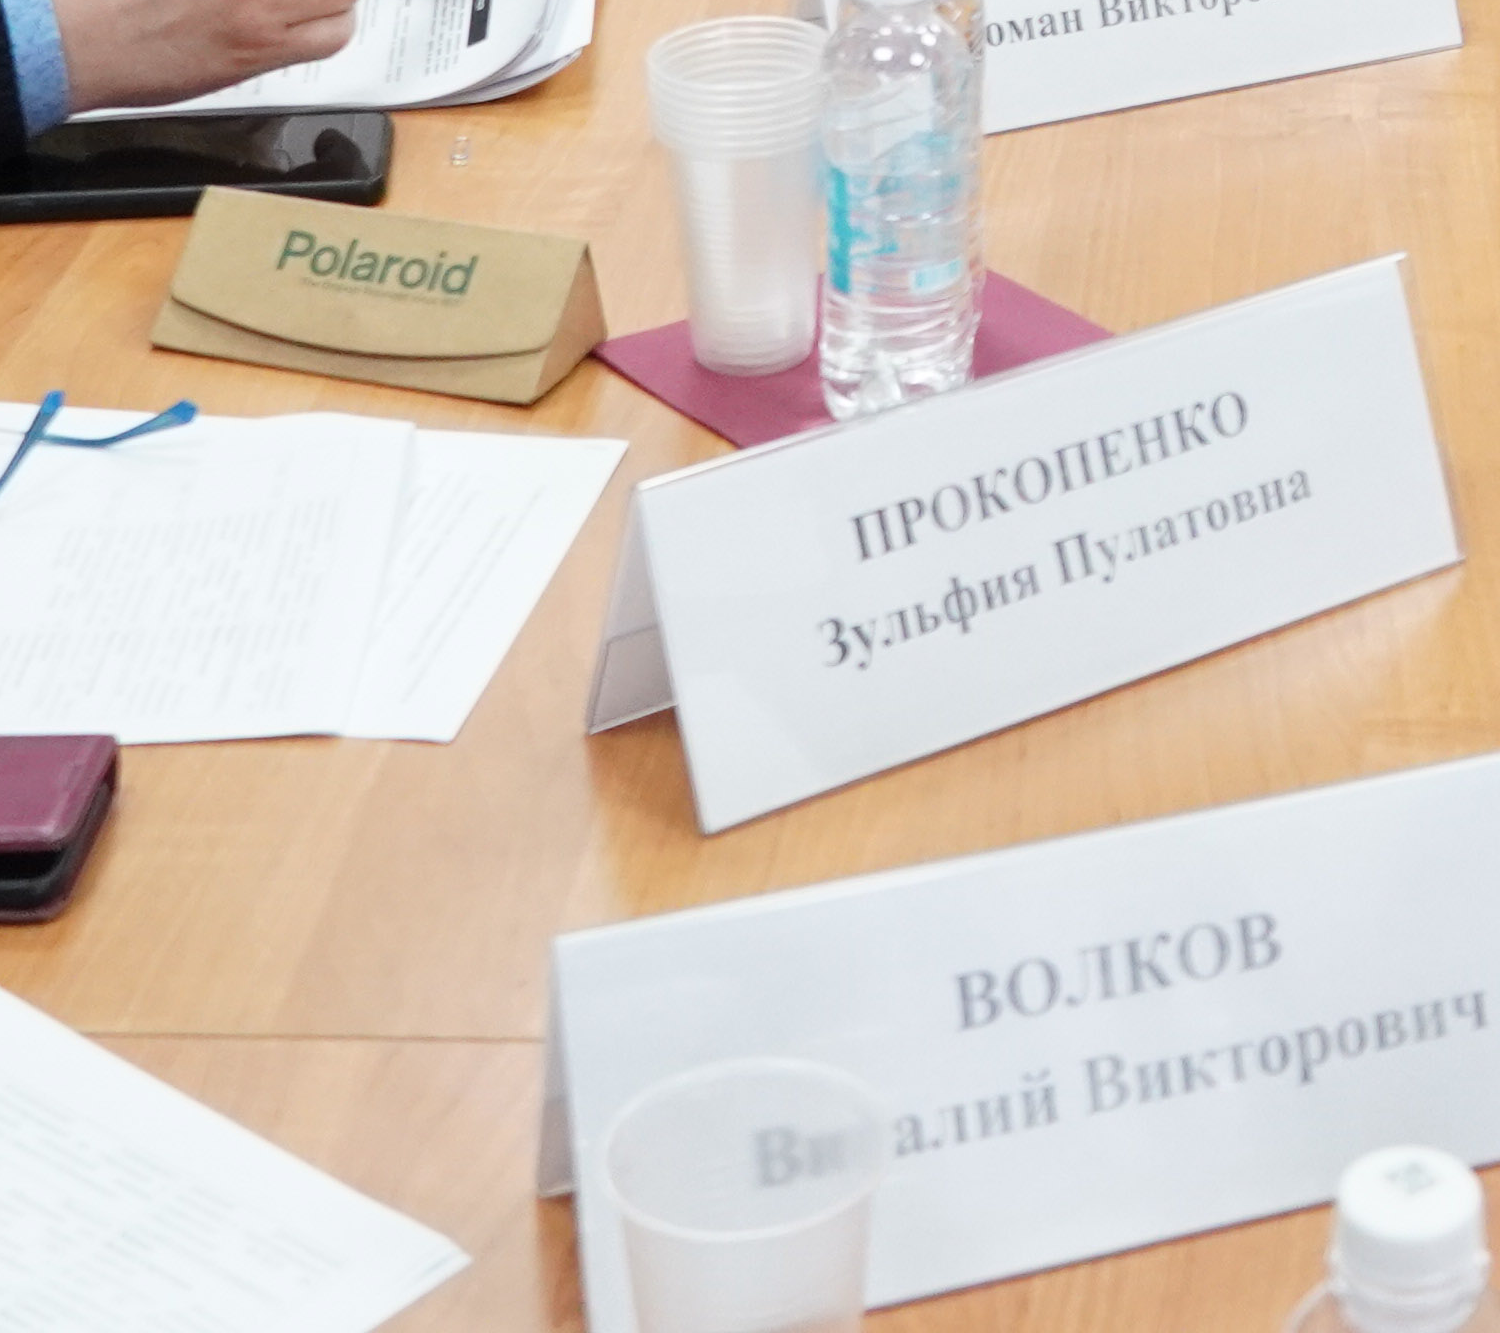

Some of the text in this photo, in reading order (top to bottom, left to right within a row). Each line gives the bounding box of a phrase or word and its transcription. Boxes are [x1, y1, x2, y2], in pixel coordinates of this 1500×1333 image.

[985, 8, 1084, 47] оман
[275, 230, 479, 297] Polaroid
[850, 389, 1250, 565] ПРОКОПЕНКО
[817, 468, 1313, 672] Зульфия Пулатовна
[952, 911, 1284, 1034] ВОЛКОВ
[1083, 988, 1492, 1118] Викторович
